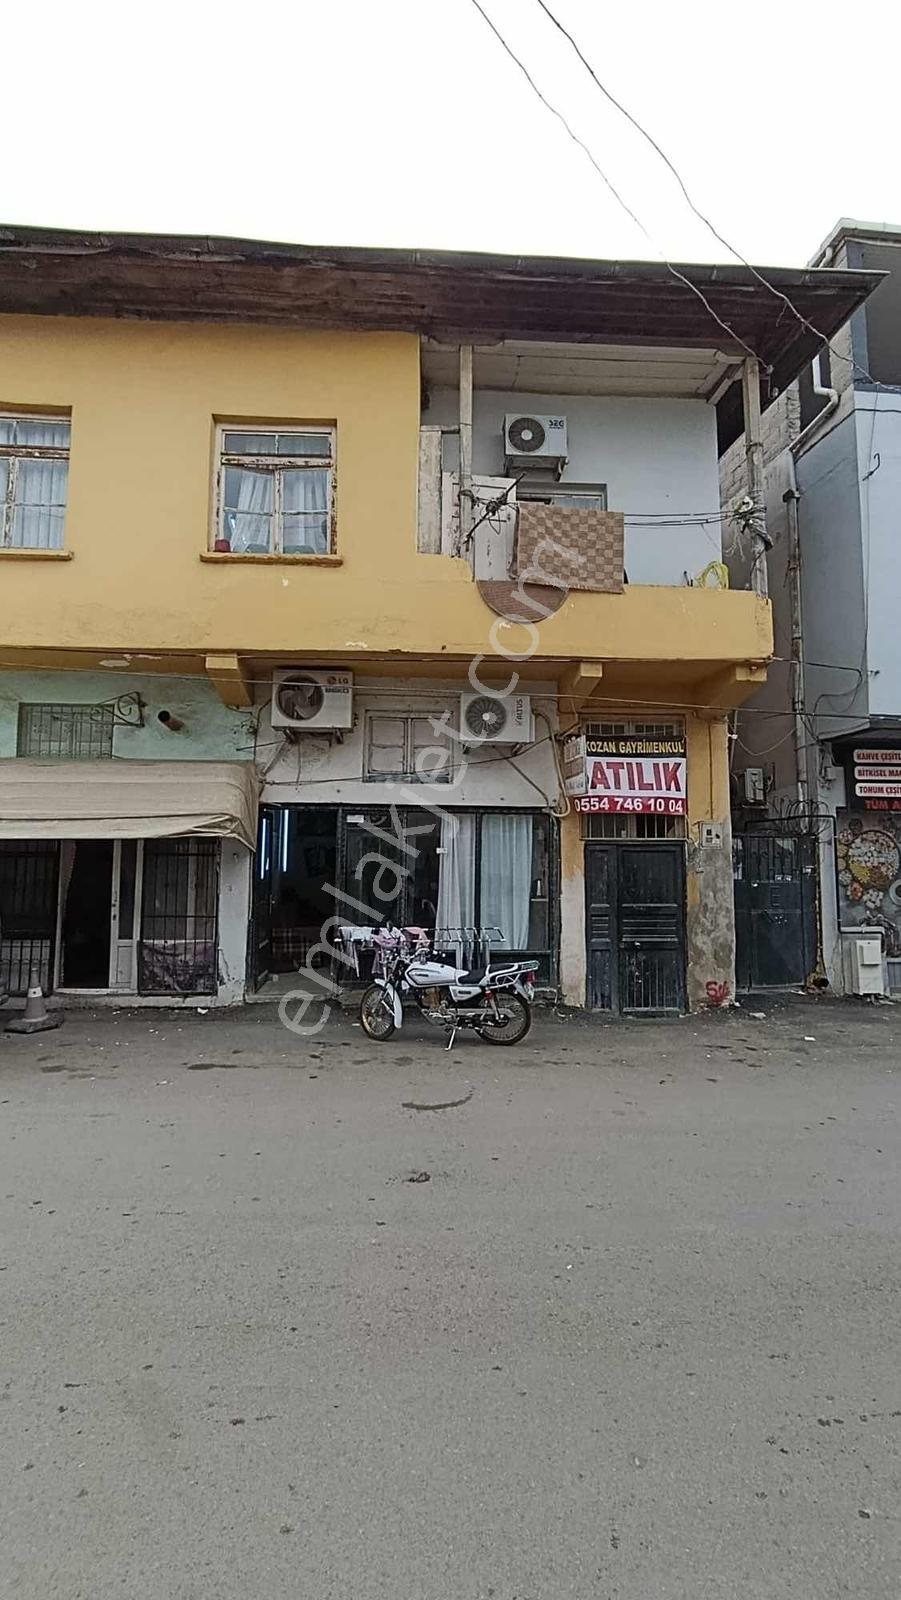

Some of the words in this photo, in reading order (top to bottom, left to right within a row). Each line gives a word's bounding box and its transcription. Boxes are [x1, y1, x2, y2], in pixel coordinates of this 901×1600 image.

[618, 739, 684, 753] GAYRİMENKUL
[856, 752, 880, 761] KAHVE
[859, 786, 885, 794] TOHUM
[574, 797, 610, 812] 0554
[614, 797, 643, 812] 746
[647, 798, 665, 812] 10
[668, 799, 683, 813] 04
